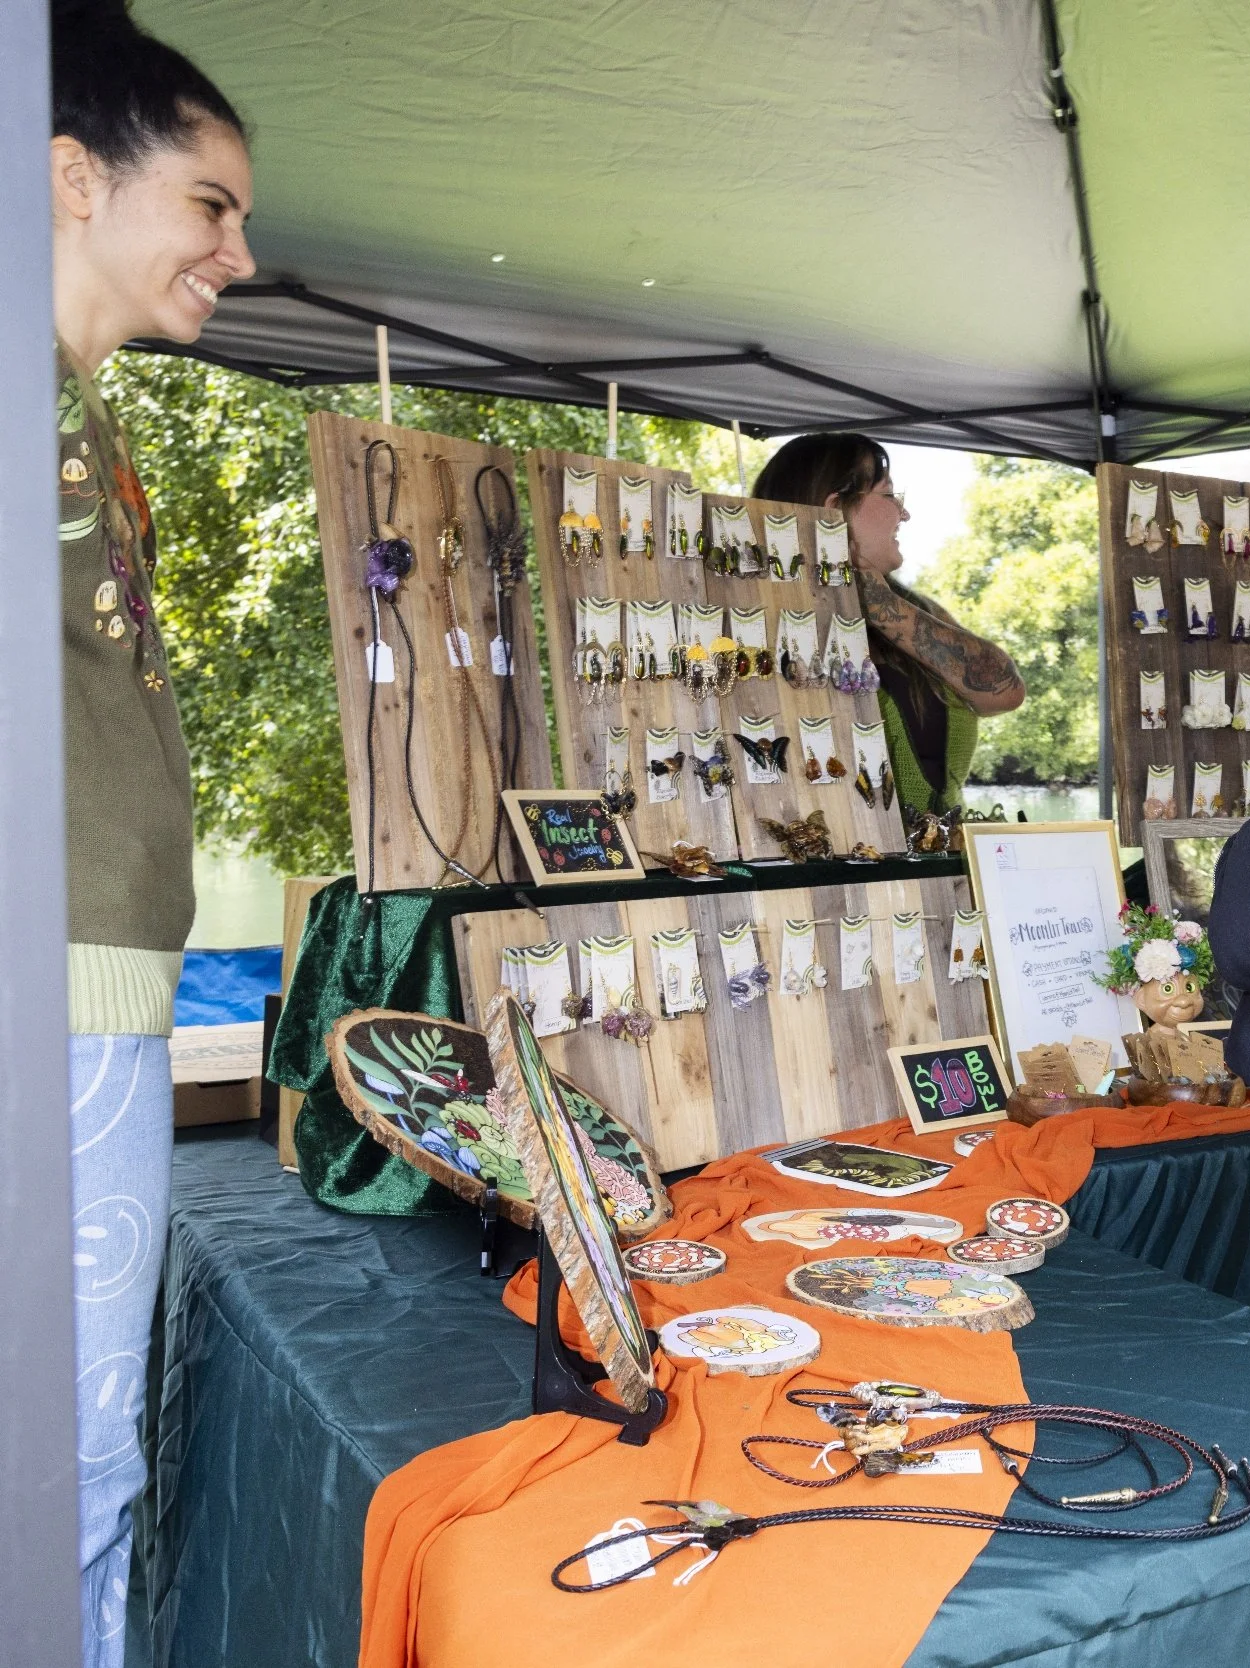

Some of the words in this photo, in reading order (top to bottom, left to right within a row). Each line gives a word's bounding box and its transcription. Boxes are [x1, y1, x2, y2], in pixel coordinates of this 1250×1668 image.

[541, 818, 599, 847] Insect
[545, 808, 572, 825] Real
[914, 1058, 977, 1116] $10
[964, 1050, 999, 1112] BOWL
